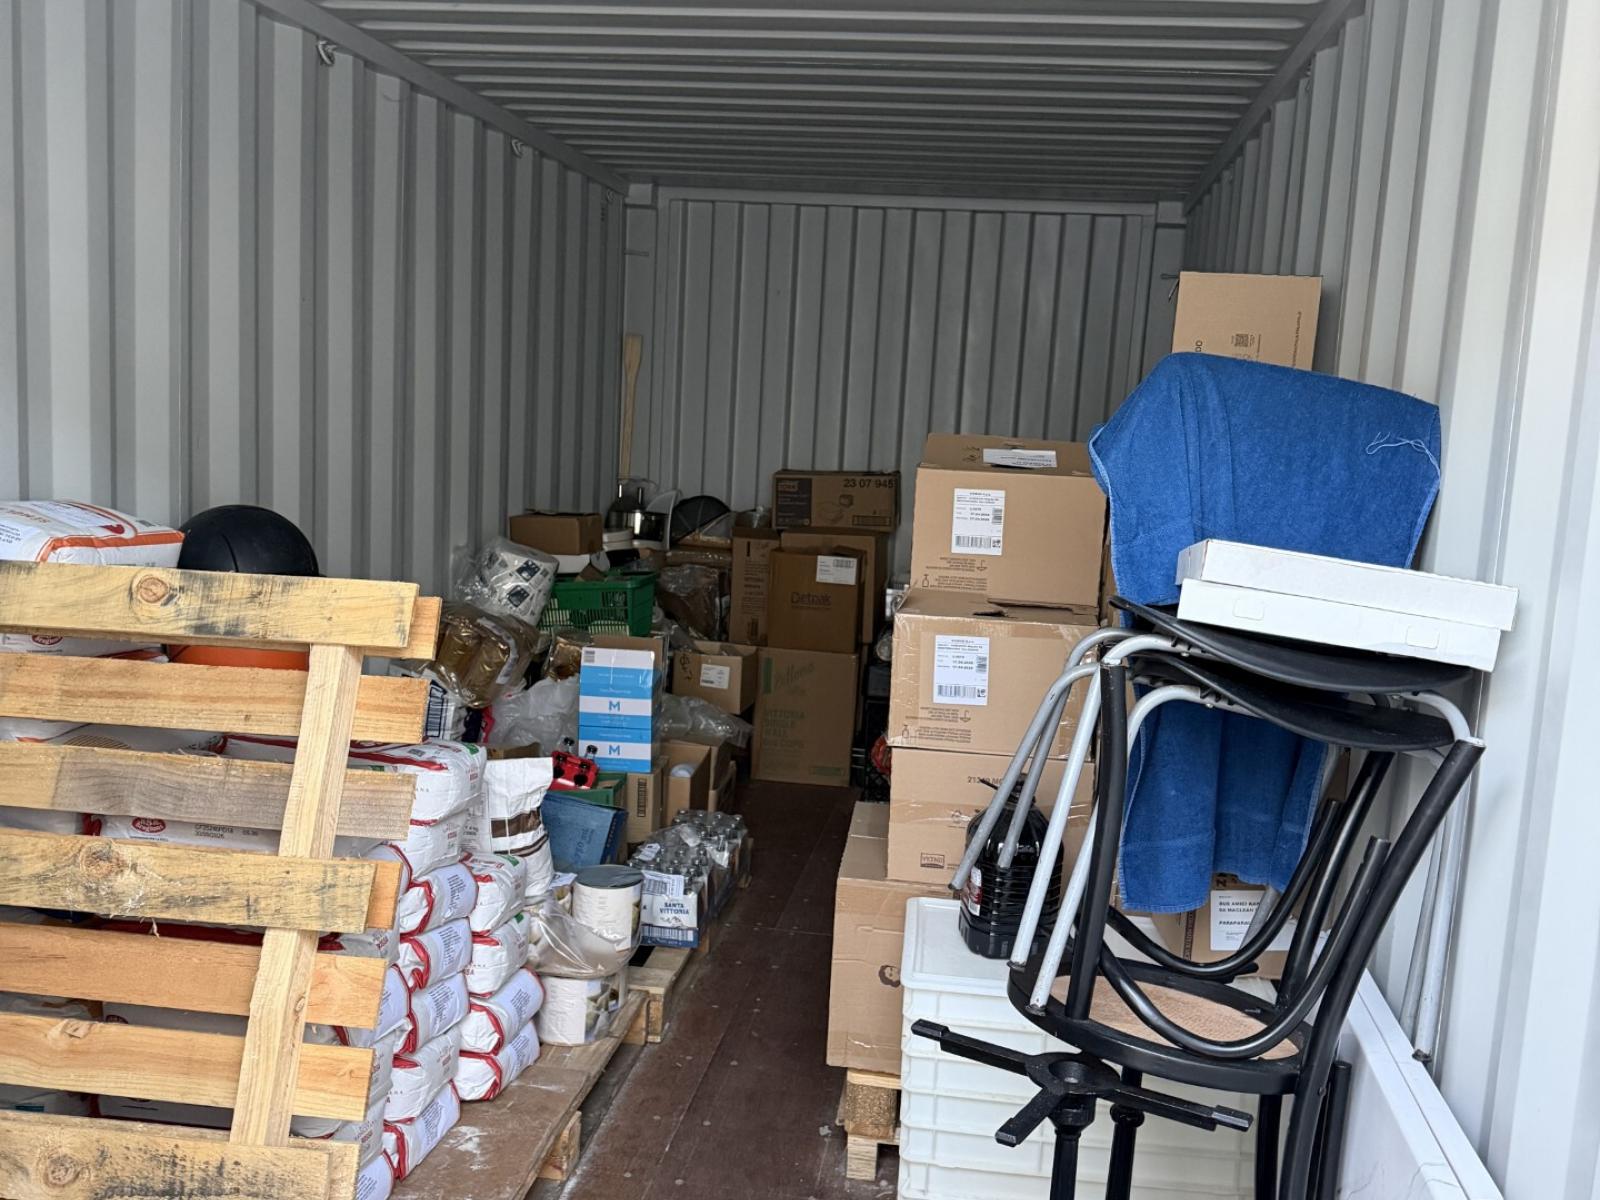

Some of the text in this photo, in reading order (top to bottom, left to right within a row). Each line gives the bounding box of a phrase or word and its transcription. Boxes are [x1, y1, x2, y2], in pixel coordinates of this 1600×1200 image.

[843, 479, 857, 488] 23
[608, 701, 621, 711] M
[608, 745, 621, 756] M
